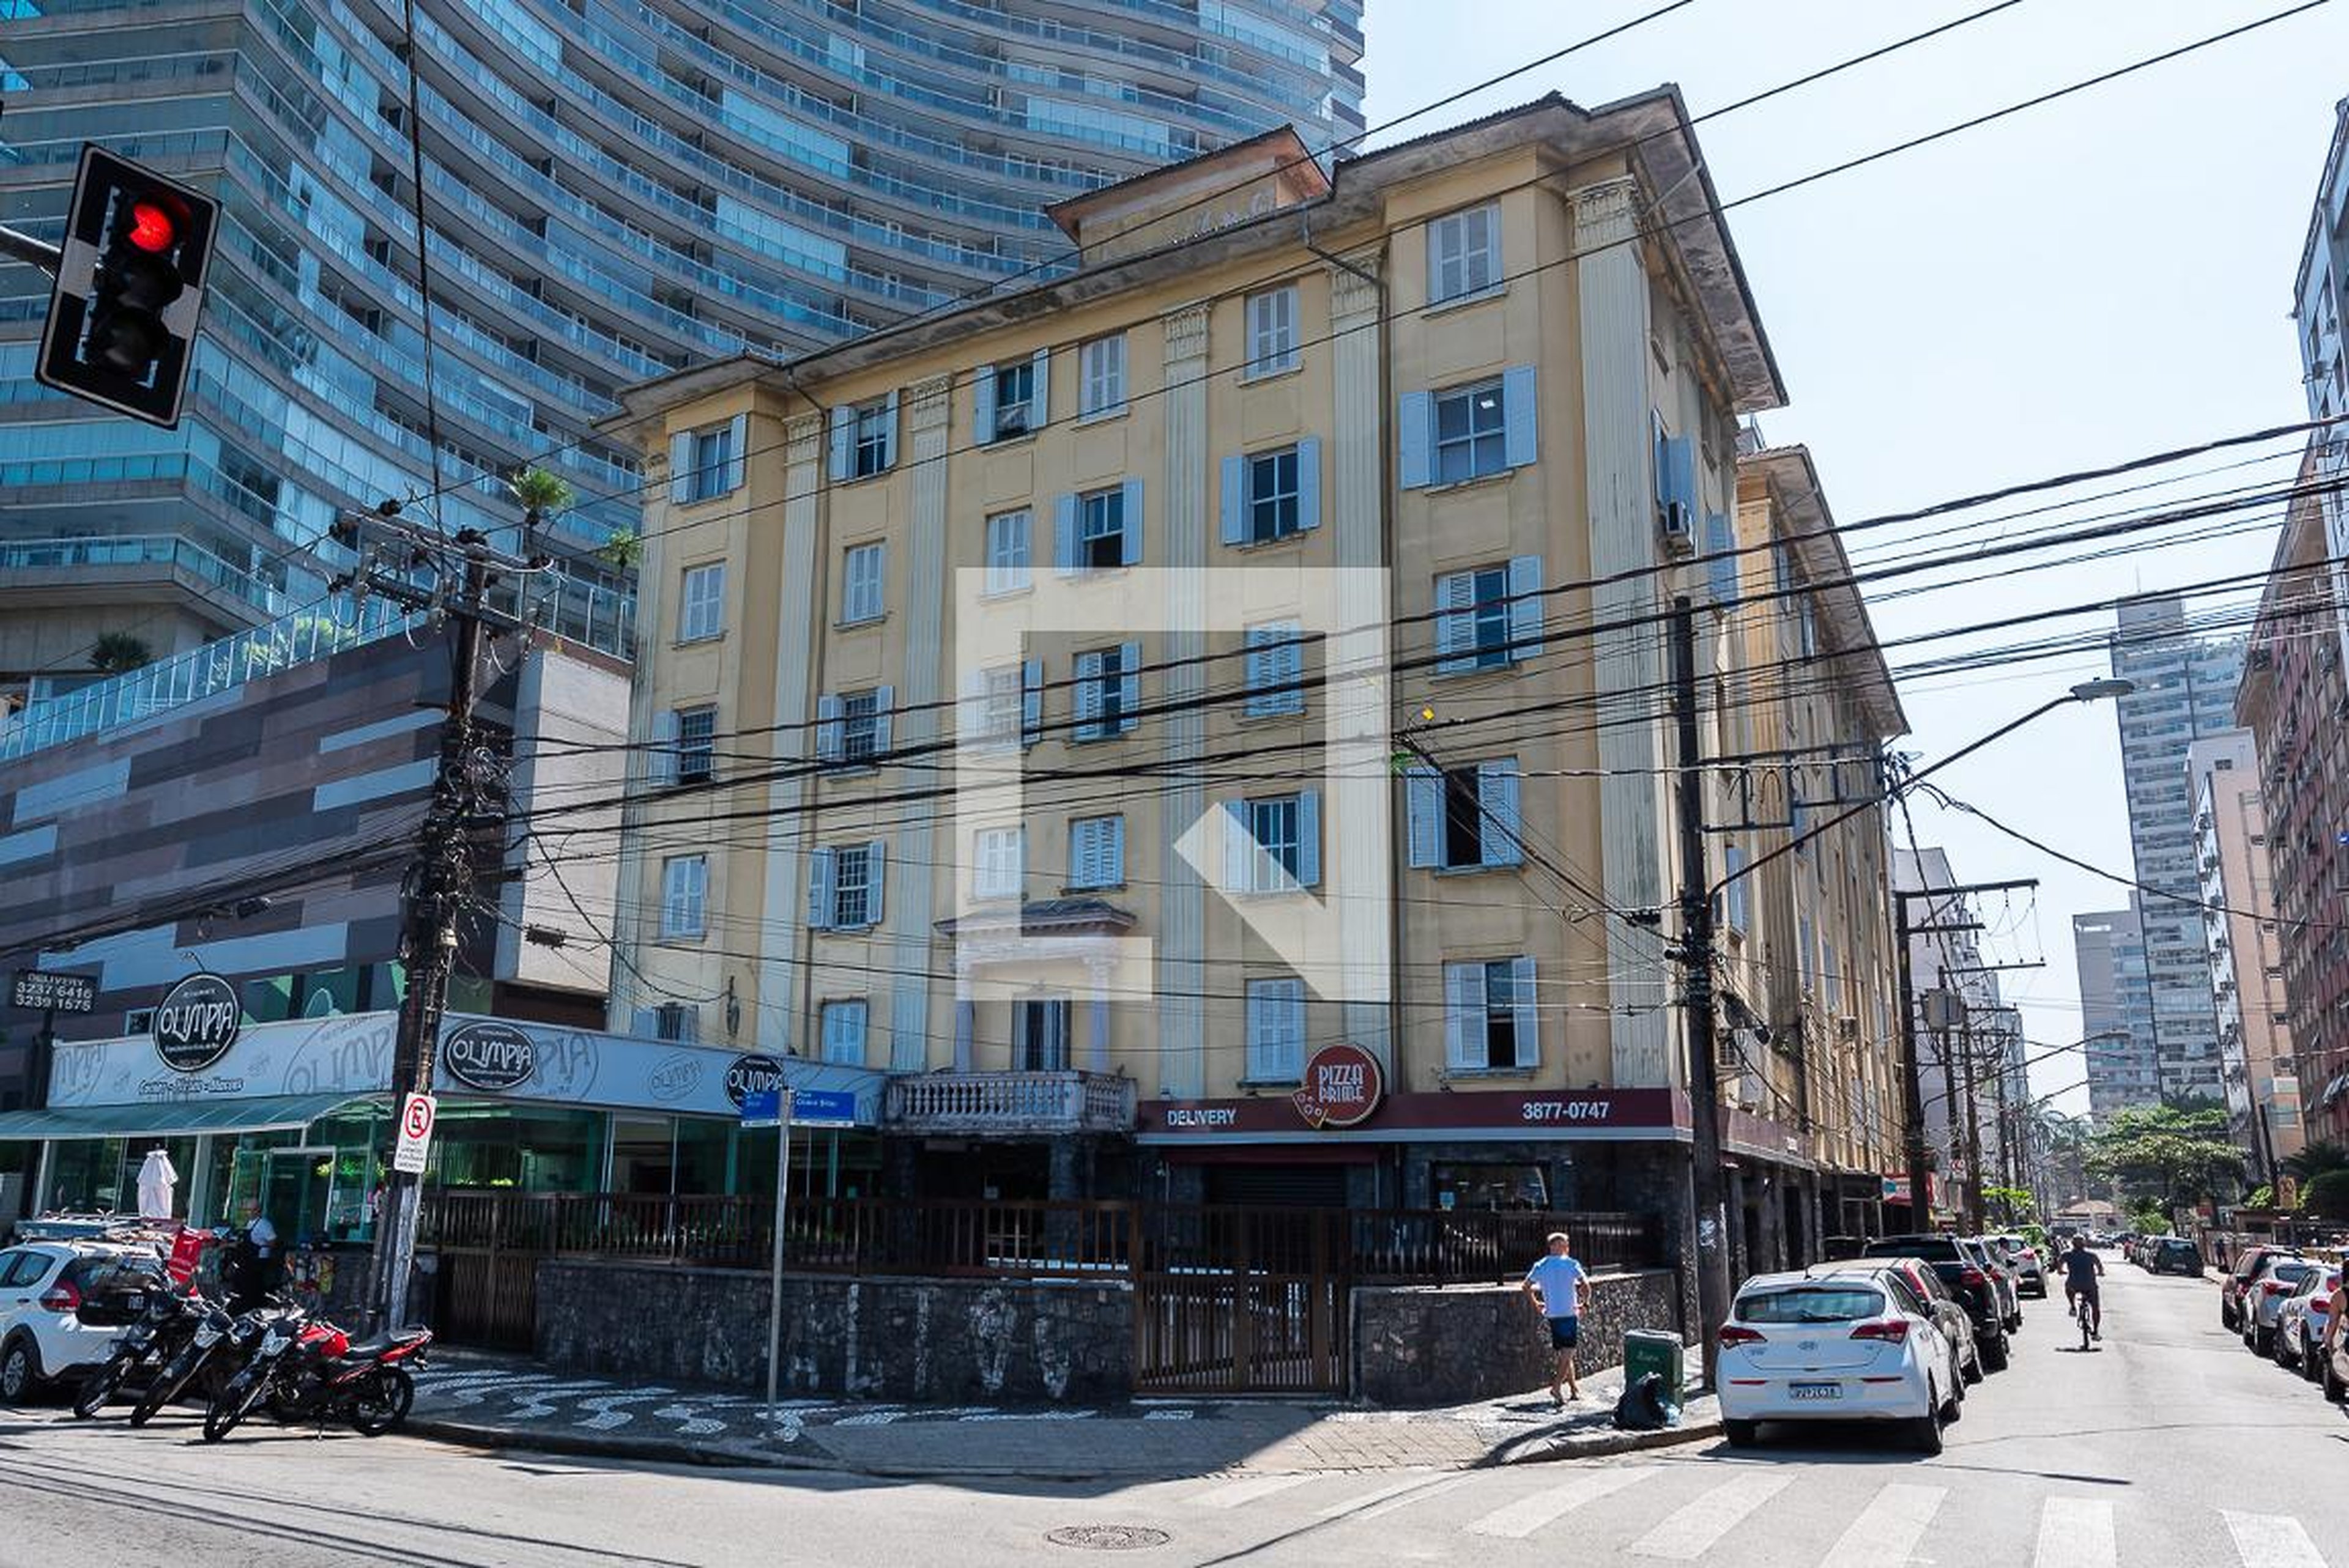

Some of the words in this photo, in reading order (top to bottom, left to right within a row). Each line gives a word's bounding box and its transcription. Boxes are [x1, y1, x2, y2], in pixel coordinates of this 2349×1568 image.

[16, 982, 53, 994] 3237
[28, 973, 84, 986] DELIVERY
[160, 1002, 233, 1041] OLIMPIA
[453, 1039, 532, 1070] OLIMPIA
[1318, 1063, 1364, 1086] PIZZA
[1318, 1085, 1364, 1103] PRIME
[1168, 1109, 1236, 1125] DELIVERY
[1523, 1102, 1609, 1120] 3877-0747
